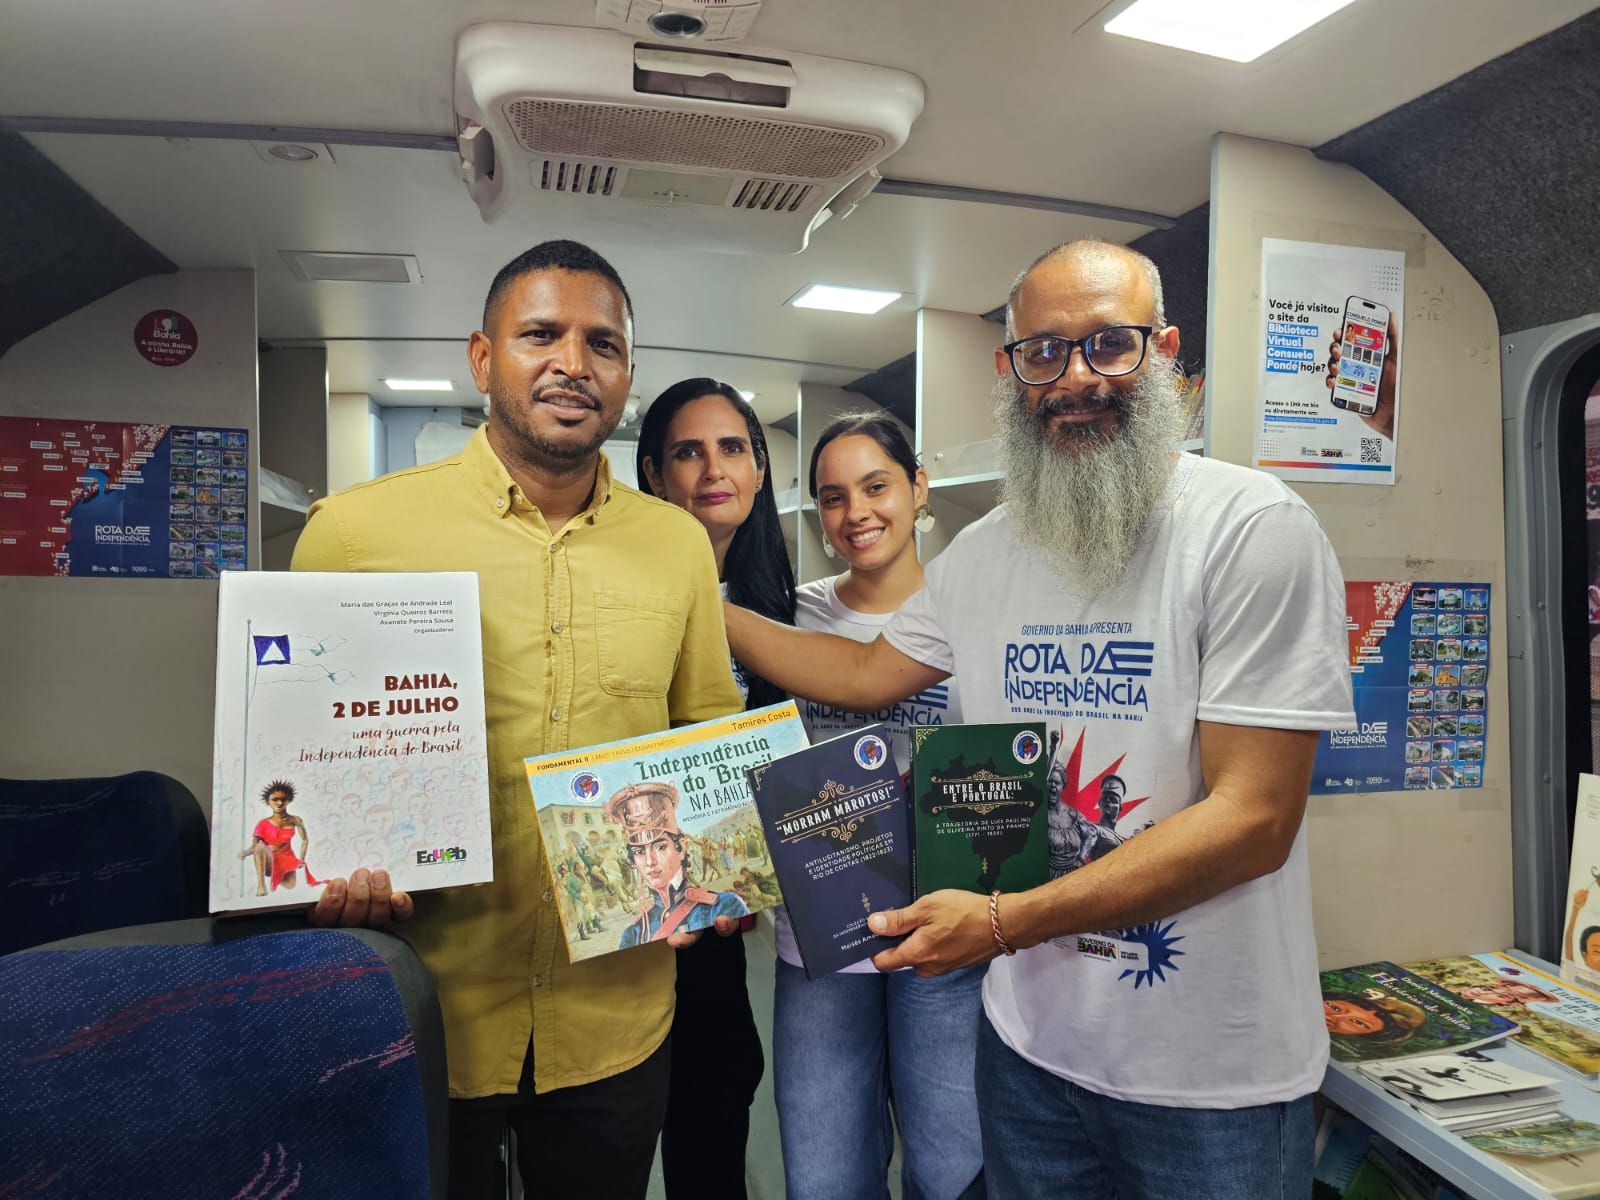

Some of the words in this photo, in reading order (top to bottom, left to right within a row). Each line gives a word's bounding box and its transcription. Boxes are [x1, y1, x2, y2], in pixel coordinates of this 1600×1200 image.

[1269, 298, 1293, 310] Você
[1294, 301, 1305, 312] já
[1307, 302, 1340, 314] visitou
[1277, 312, 1295, 322] site
[1297, 314, 1309, 323] da
[153, 329, 181, 340] Bahia
[1268, 323, 1317, 336] Biblioteca
[1268, 335, 1302, 347] Virtual
[1267, 347, 1313, 360] Consuelo
[1267, 359, 1298, 371] Pondé
[1300, 362, 1326, 374] hoje?
[95, 525, 123, 535] ROTA
[375, 601, 399, 609] Graças
[373, 610, 399, 618] Virgínia
[1022, 624, 1054, 636] GOVERNO
[1056, 625, 1064, 636] DA
[1065, 623, 1089, 636] BAHIA
[1089, 621, 1133, 634] APRESENTA
[1004, 643, 1072, 678] ROTA
[385, 673, 458, 691] BAHIA,
[1004, 676, 1149, 712] INDEPENDÊNCIA
[332, 702, 346, 719] 2
[351, 700, 380, 718] DE
[386, 696, 459, 716] JULHO
[731, 717, 767, 732] Tamires
[768, 710, 791, 722] Costa
[1086, 711, 1109, 720] BRASIL
[1125, 714, 1143, 722] BAHIA
[352, 728, 382, 740] uma
[386, 725, 430, 741] guerra
[433, 720, 460, 738] pela
[298, 745, 398, 763] Independência
[401, 741, 417, 756] do
[421, 738, 463, 754] Brasil
[633, 735, 770, 781] Independência
[537, 758, 584, 771] FUNDAMENTAL
[682, 773, 706, 794] do
[943, 783, 973, 795] ENTRE
[978, 783, 984, 792] O
[989, 781, 1022, 792] BRASIL
[690, 793, 712, 812] NA
[714, 781, 752, 806] BAHIA
[952, 793, 957, 803] E
[962, 791, 1014, 802] PORTUGAL:
[776, 808, 832, 836] “MORRAM
[861, 831, 894, 847] PROJETOS
[814, 855, 851, 873] IDENTIDADE
[851, 842, 883, 857] POLÍTICAS
[883, 838, 894, 847] EM
[812, 872, 824, 880] RIO
[825, 869, 834, 877] DE
[834, 858, 860, 872] CONTAS
[862, 933, 876, 943] Ama
